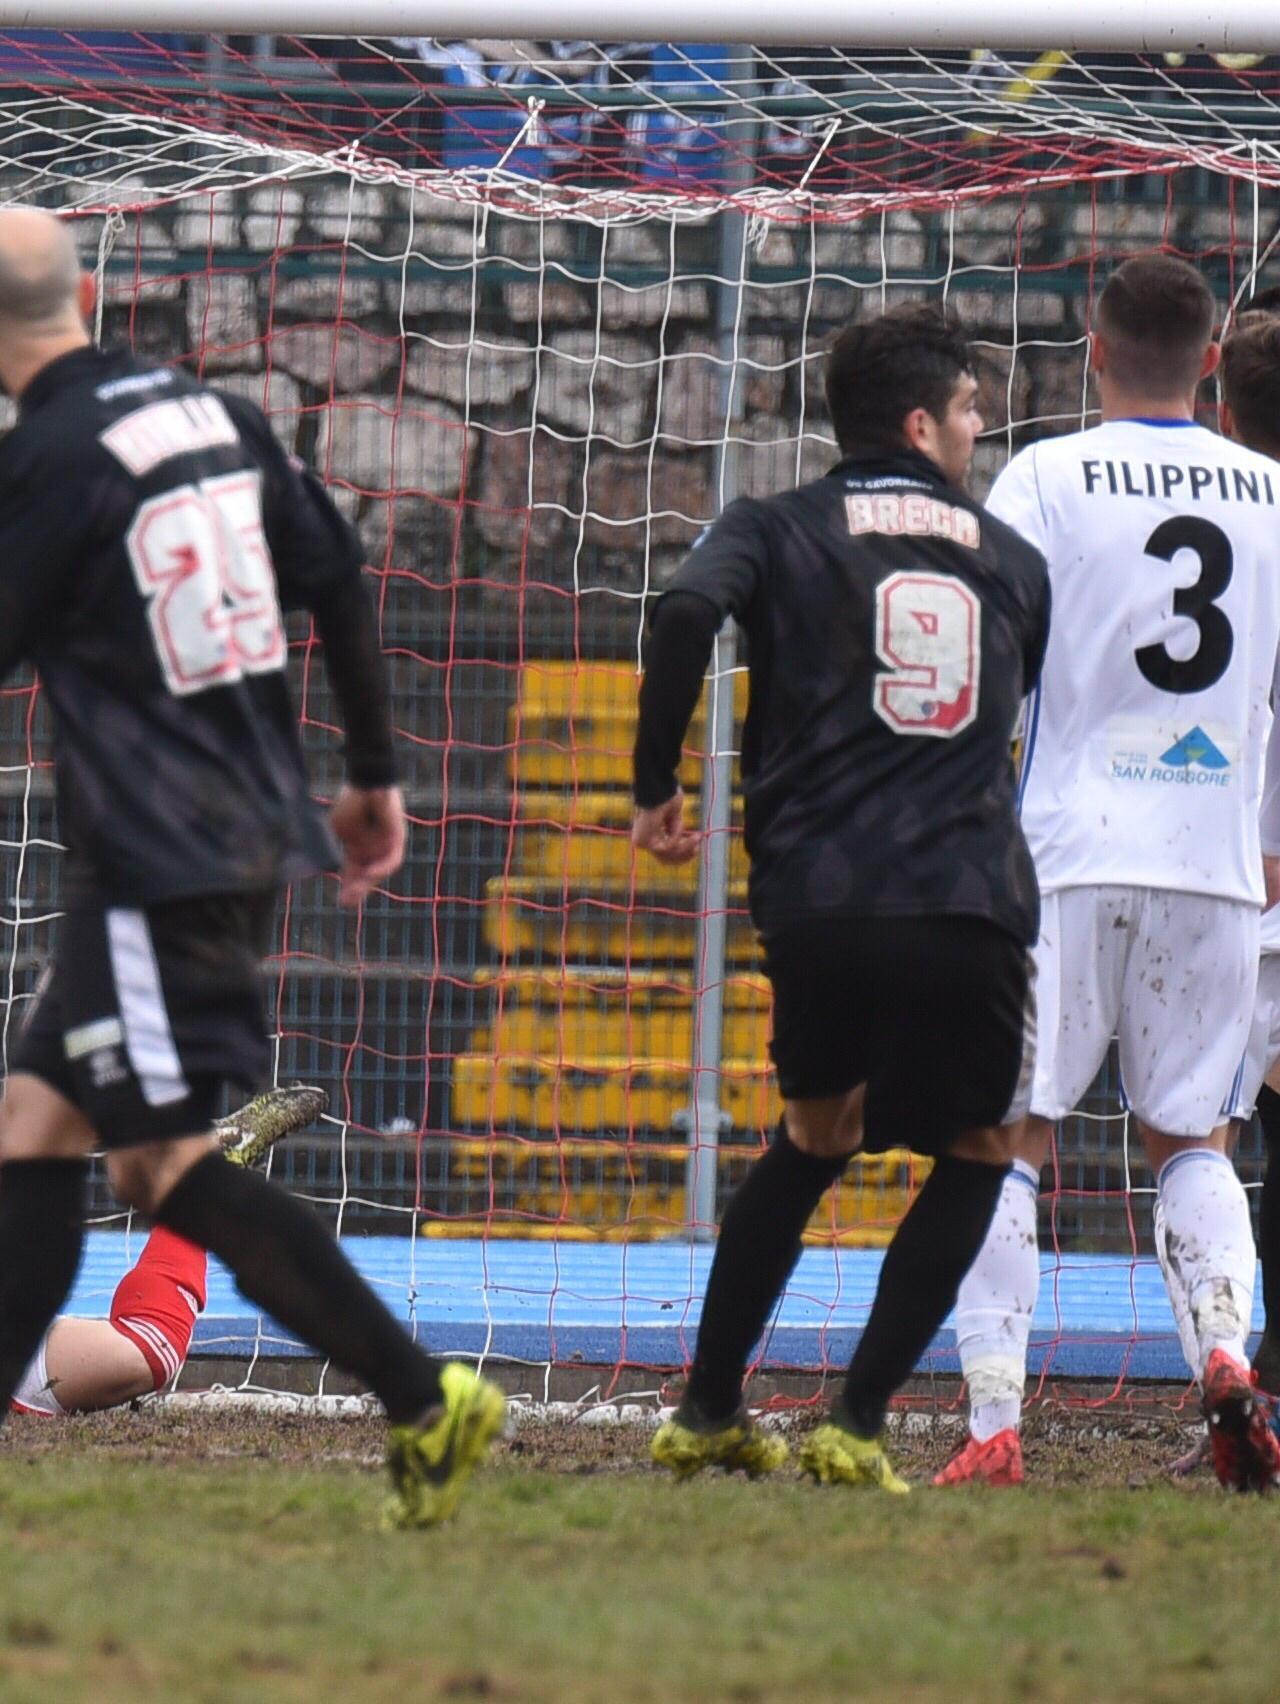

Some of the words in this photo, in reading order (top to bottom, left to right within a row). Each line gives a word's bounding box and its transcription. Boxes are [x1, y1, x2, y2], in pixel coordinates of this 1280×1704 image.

[1081, 460, 1275, 506] FILIPPINI
[126, 469, 289, 696] 25
[873, 569, 981, 739] 9
[1134, 514, 1234, 695] 3
[1111, 764, 1146, 780] SAN
[1150, 767, 1232, 787] ROSSORE
